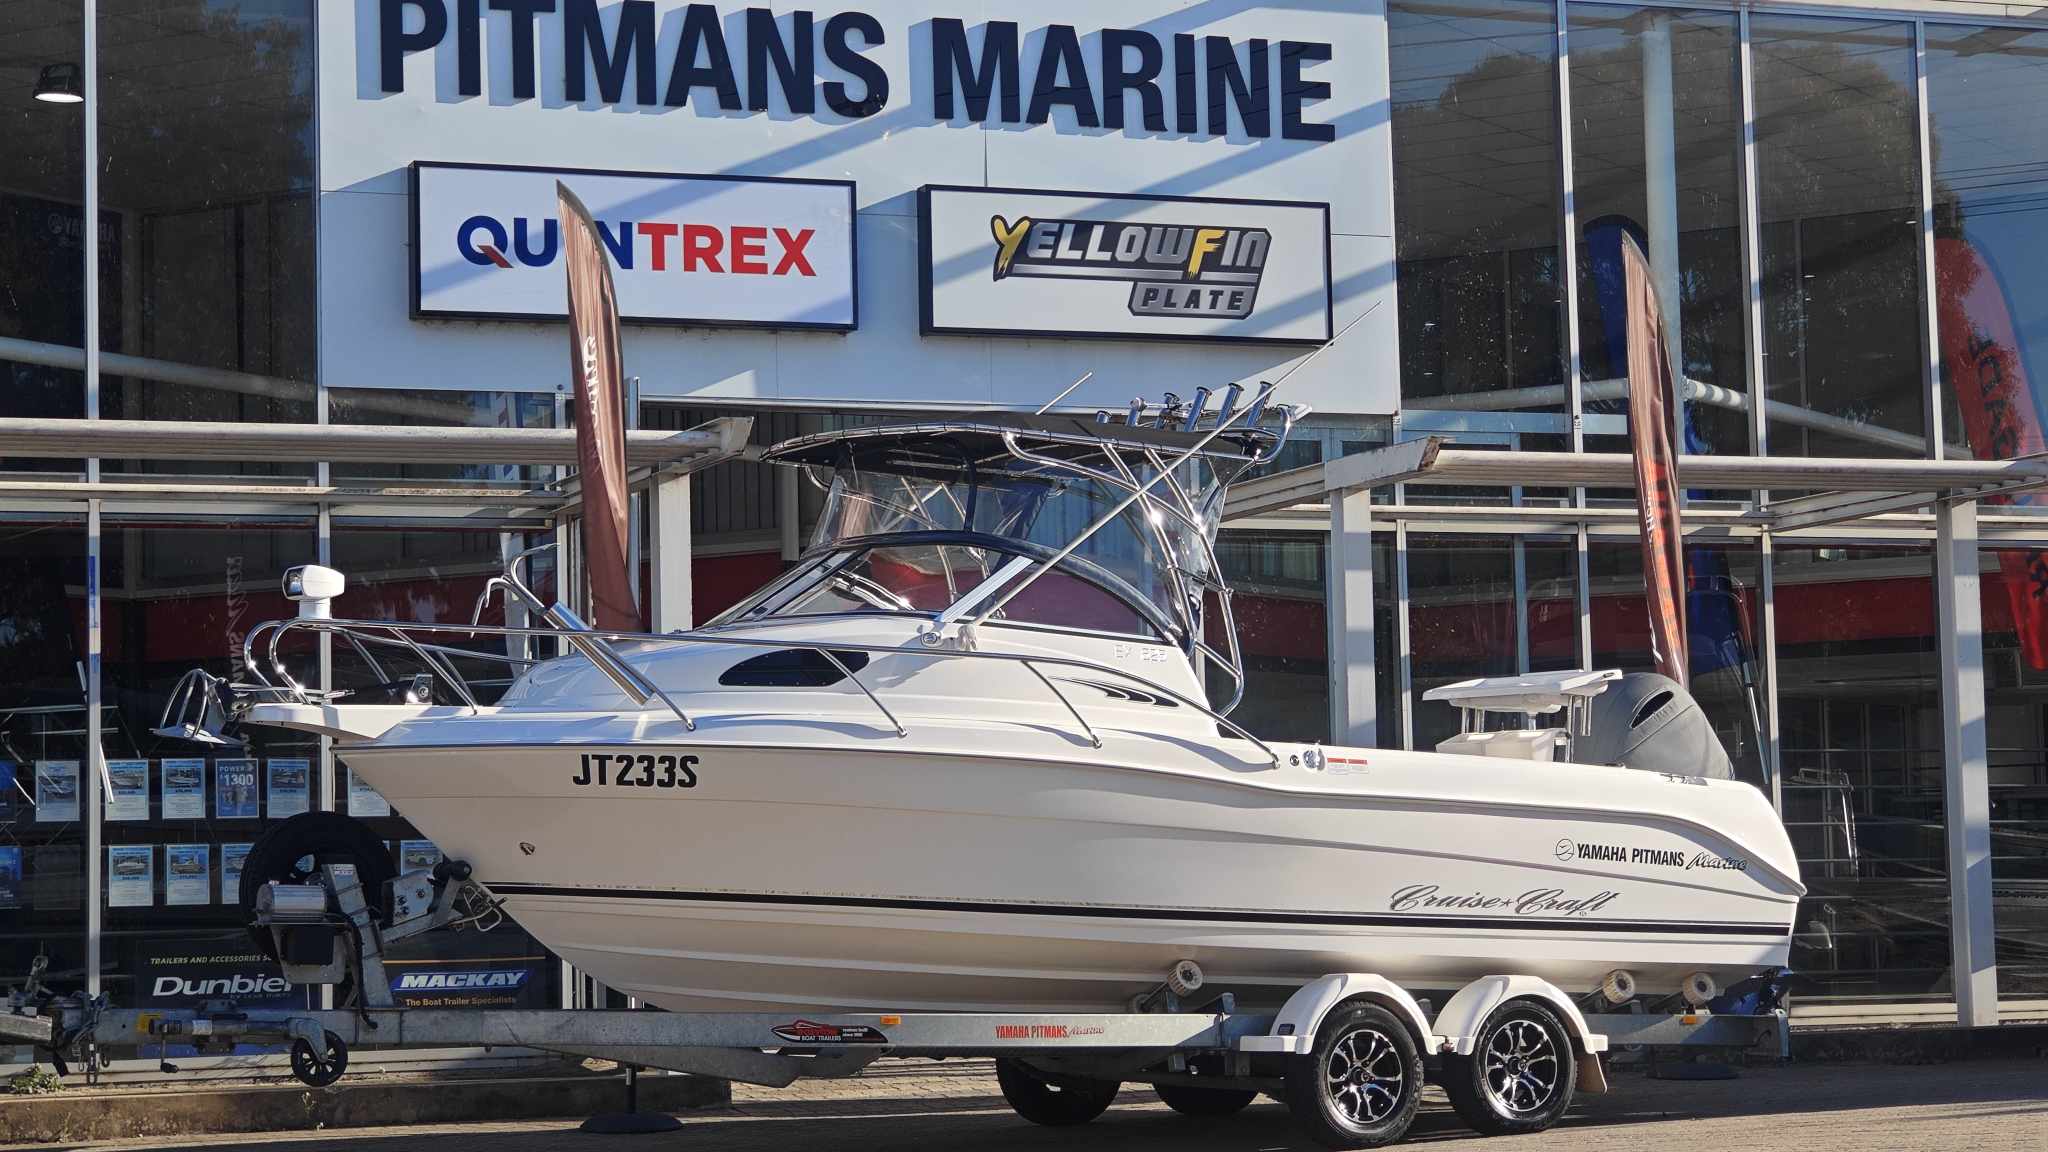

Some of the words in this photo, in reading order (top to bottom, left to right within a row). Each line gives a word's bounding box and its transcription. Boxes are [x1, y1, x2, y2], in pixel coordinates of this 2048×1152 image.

[380, 0, 890, 118] PITMANS
[931, 17, 1336, 142] MARINE
[456, 215, 817, 277] QUNTREX
[991, 213, 1272, 281] YELLOWFIN
[1141, 286, 1244, 312] PLATE
[573, 754, 700, 788] JT233S
[1577, 842, 1627, 863] YAMAHA
[1632, 847, 1685, 867] PITMANS
[1685, 851, 1748, 871] Marine
[1389, 884, 1501, 912] Cruise
[1514, 888, 1623, 916] Craft
[150, 957, 188, 965] TRAILERS
[190, 956, 208, 964] AND
[209, 955, 261, 963] ACCESSORIES
[400, 972, 525, 988] MACKAY
[406, 998, 421, 1006] The
[422, 998, 442, 1006] Boat
[444, 997, 470, 1005] Trailer
[995, 1025, 1029, 1039] YAMAHA
[1031, 1025, 1067, 1038] PITMANS
